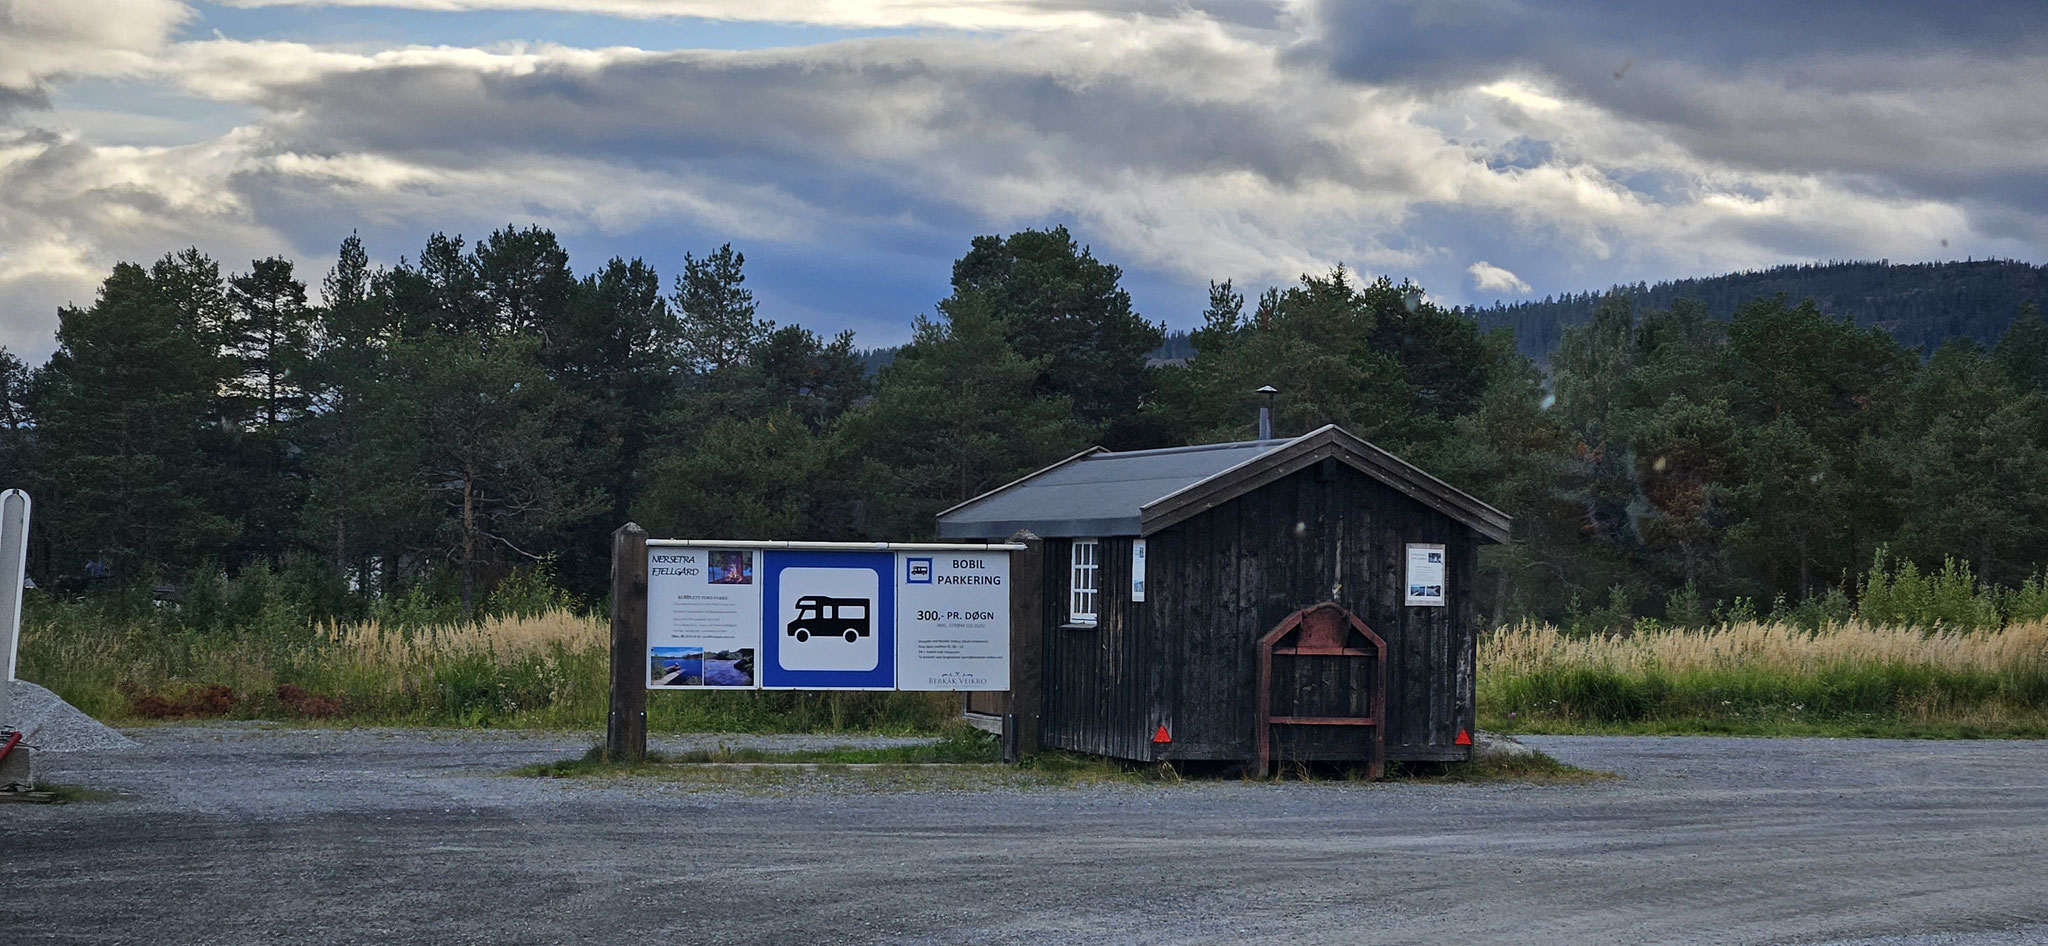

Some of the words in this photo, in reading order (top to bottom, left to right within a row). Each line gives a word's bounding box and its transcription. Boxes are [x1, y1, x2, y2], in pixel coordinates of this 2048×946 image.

[652, 555, 695, 563] NERSETRA
[952, 559, 985, 569] BOBIL
[652, 567, 699, 576] FJELLGÅRD
[937, 575, 1001, 586] PARKERING
[916, 610, 944, 621] 300,-
[946, 611, 963, 620] PR.
[964, 610, 994, 621] DØGN
